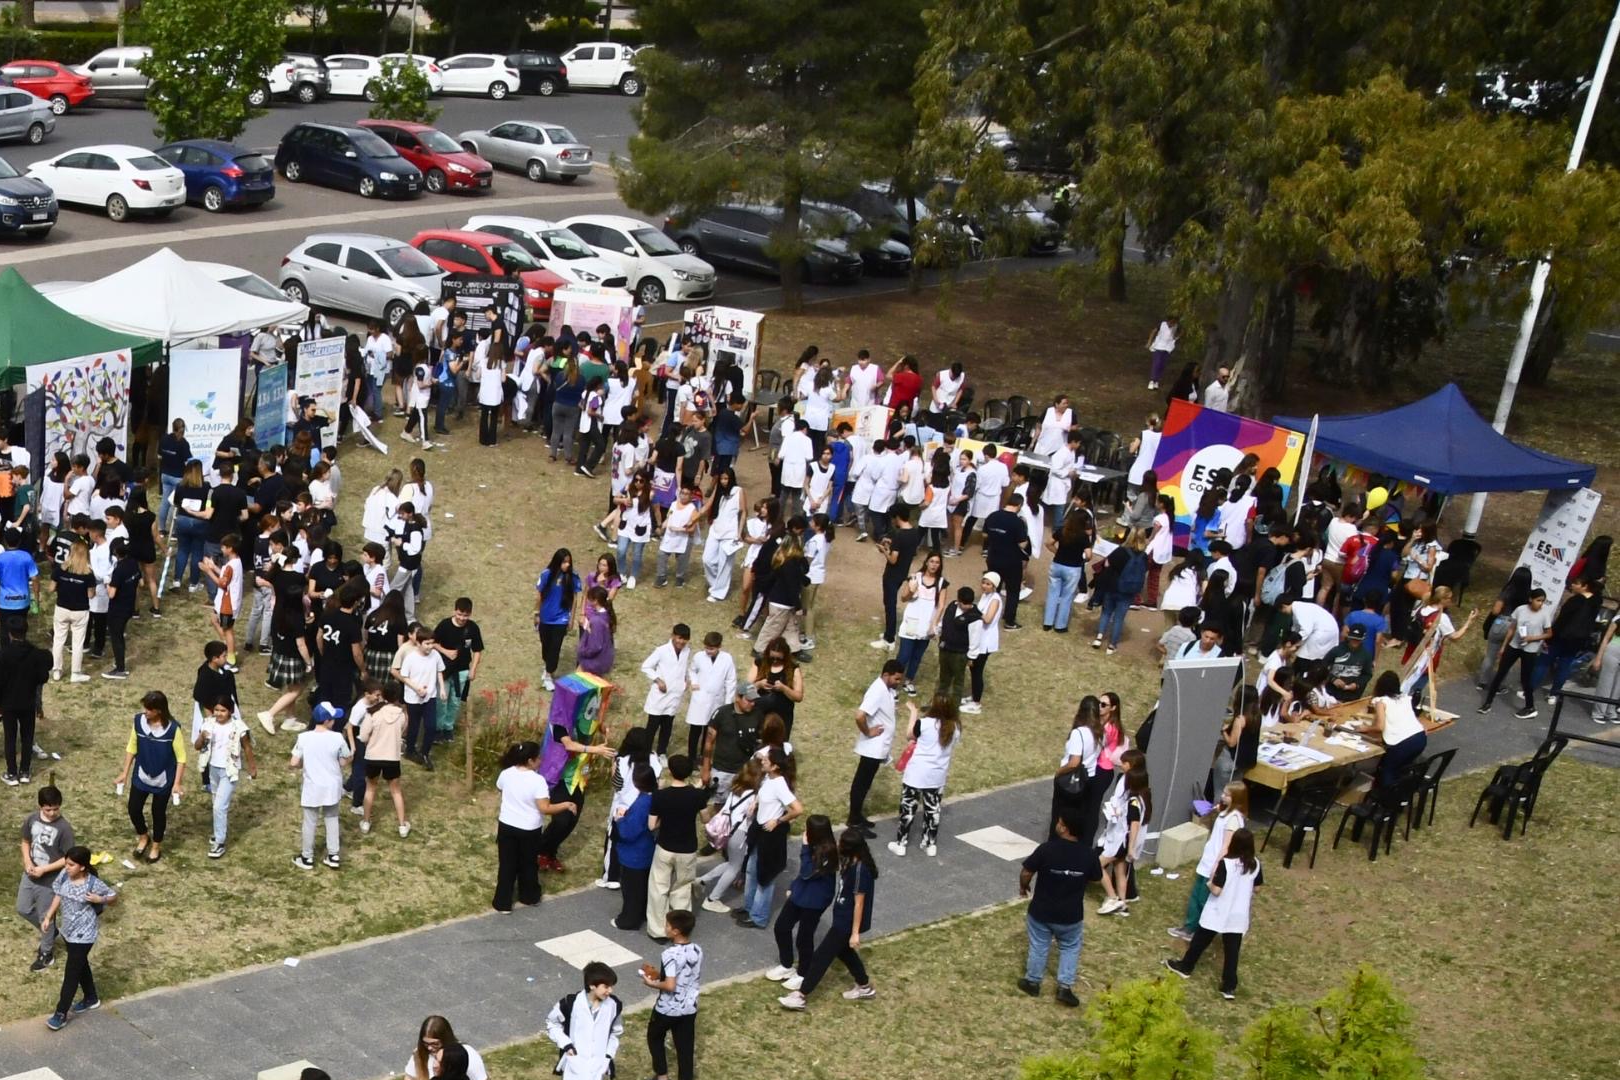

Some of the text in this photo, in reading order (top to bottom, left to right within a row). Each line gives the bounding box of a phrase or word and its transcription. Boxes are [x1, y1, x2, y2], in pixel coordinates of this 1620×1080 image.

[693, 313, 742, 329] BASTA DE
[192, 422, 232, 433] PAMPA
[1536, 541, 1552, 555] ES
[322, 624, 341, 646] 24
